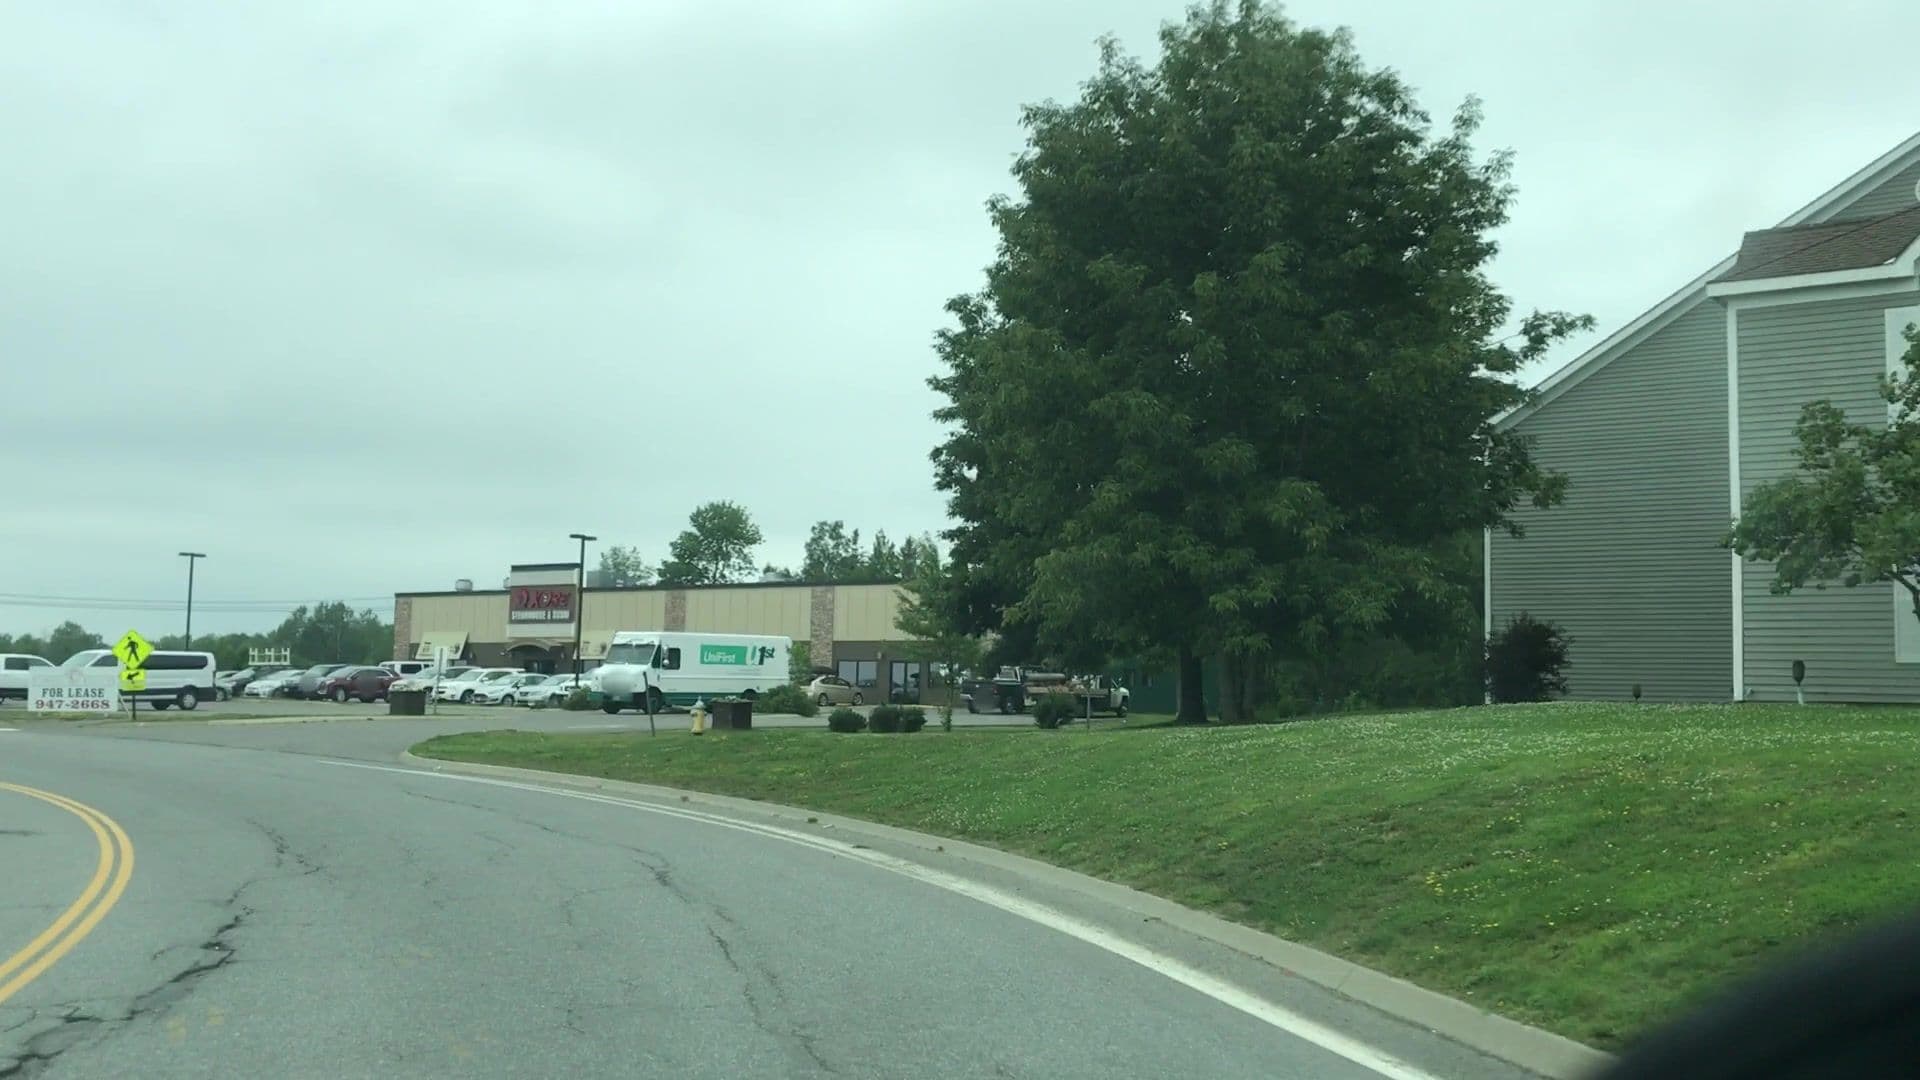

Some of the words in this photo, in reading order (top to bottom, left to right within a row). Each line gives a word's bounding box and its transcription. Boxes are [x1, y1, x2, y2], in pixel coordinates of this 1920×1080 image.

[42, 688, 63, 698] FOR
[68, 688, 105, 698] LEASE
[35, 699, 110, 710] 947-2668
